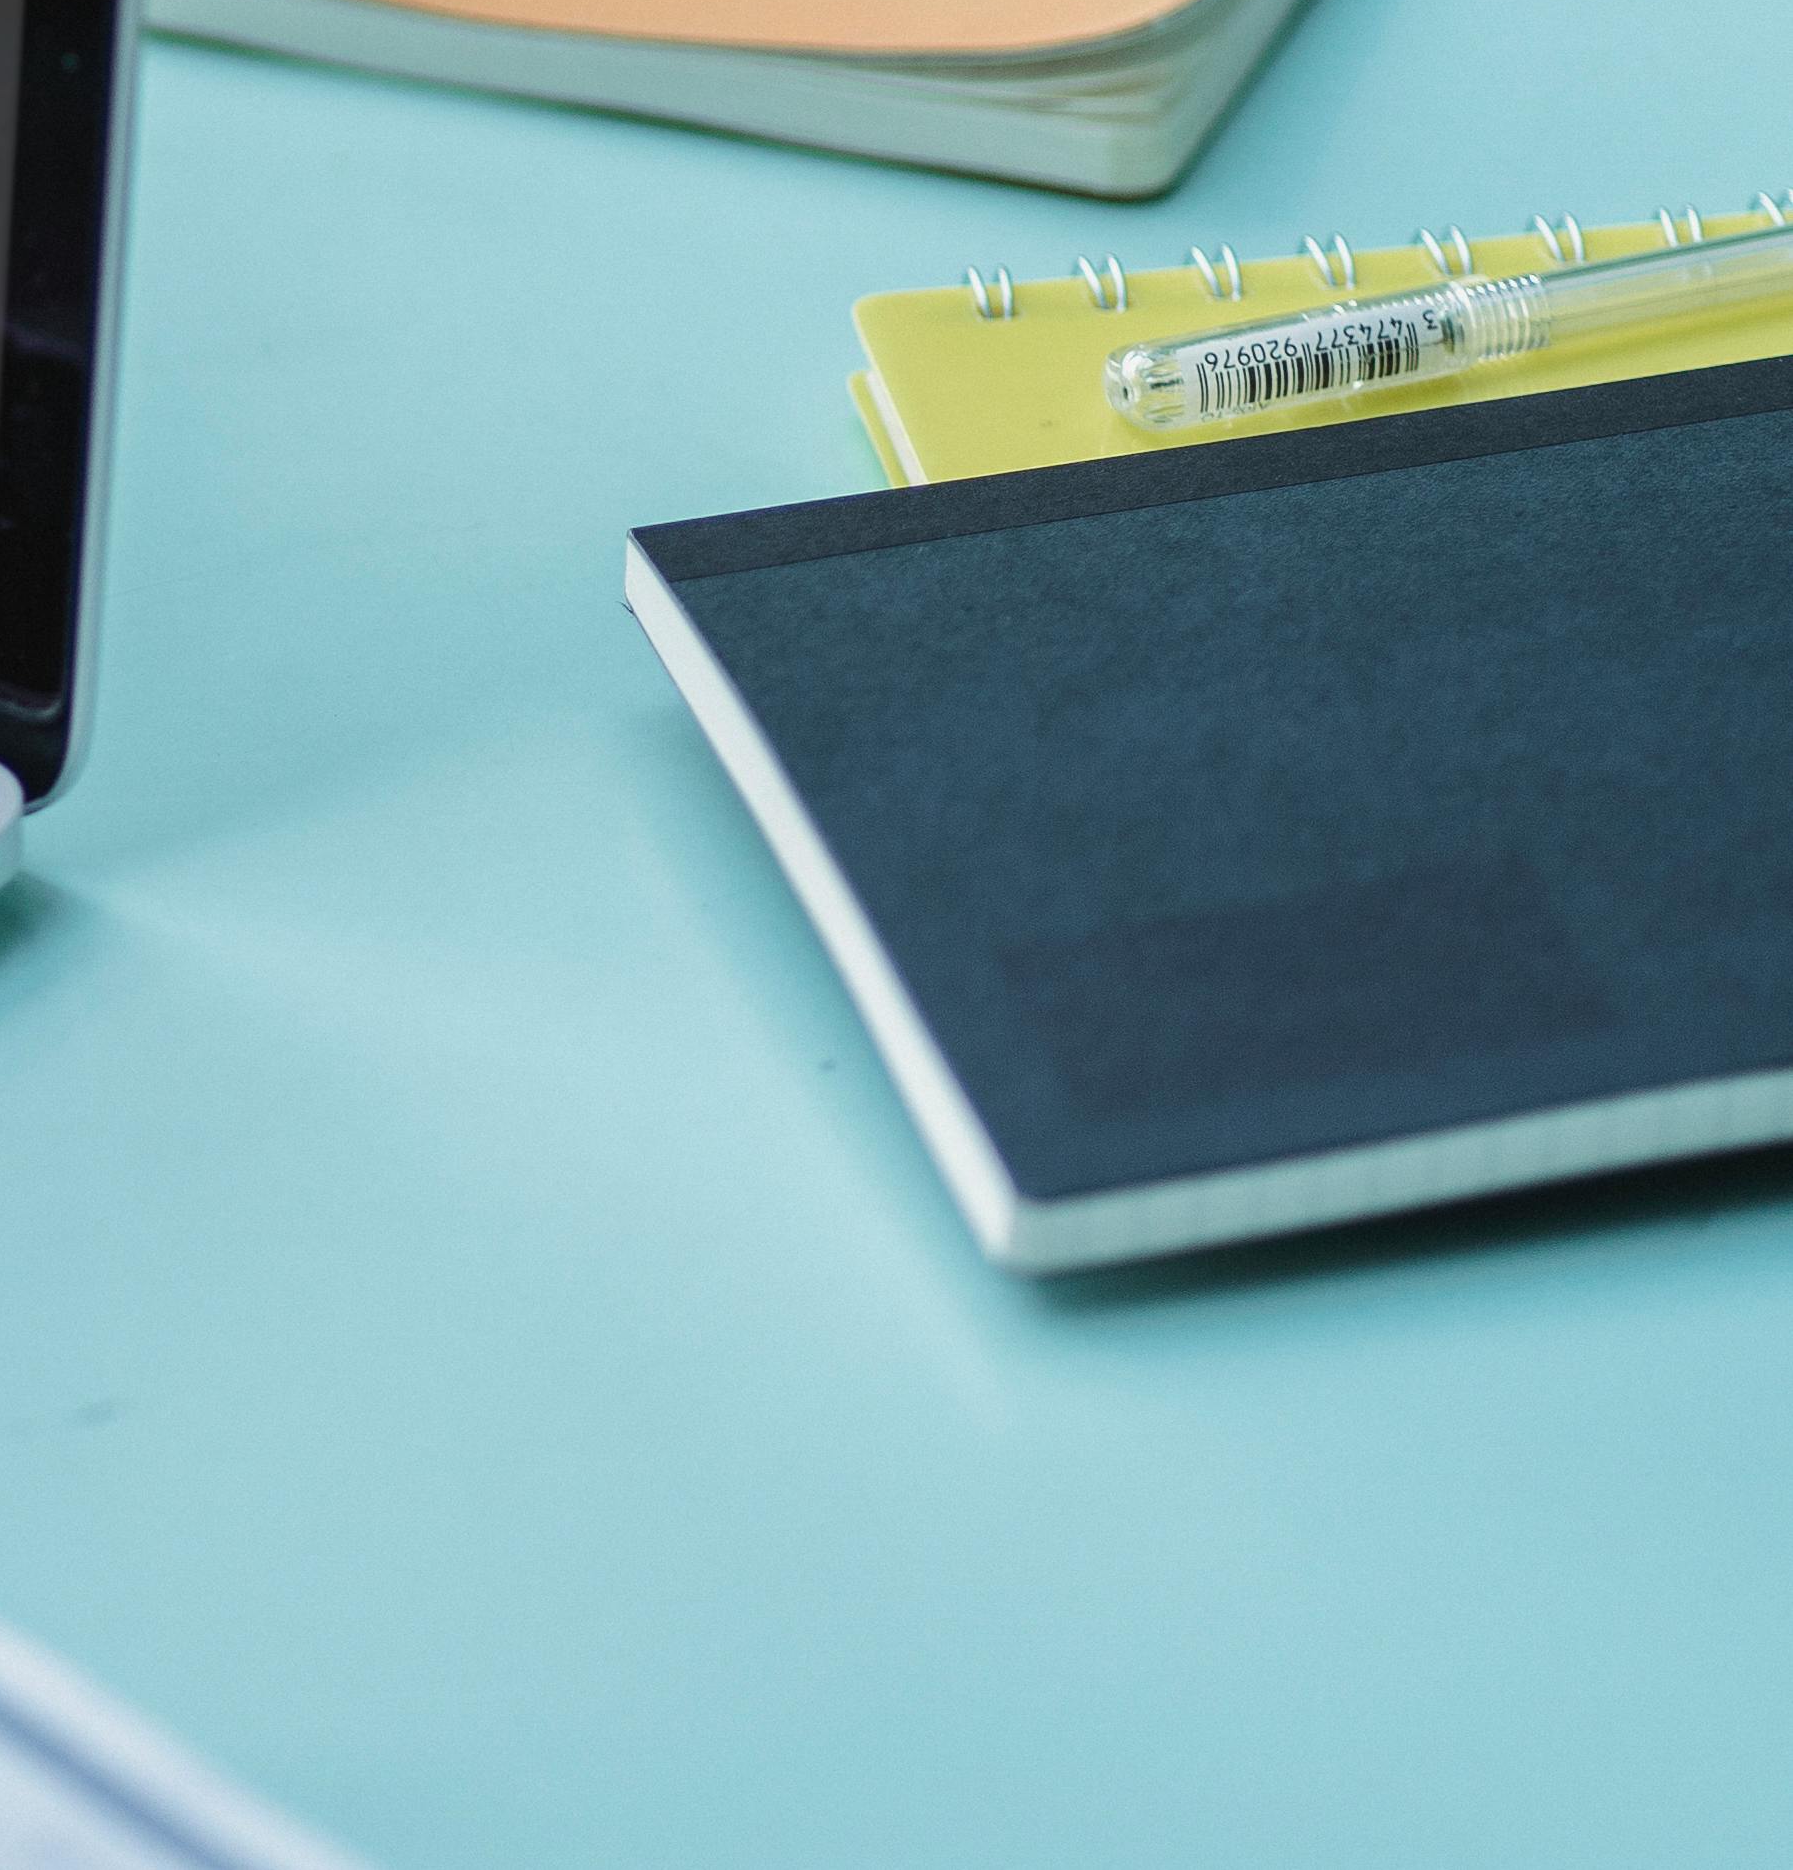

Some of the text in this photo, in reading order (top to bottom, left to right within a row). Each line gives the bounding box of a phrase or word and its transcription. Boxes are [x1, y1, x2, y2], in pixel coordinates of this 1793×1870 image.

[1203, 308, 1439, 373] 3 474377 920976
